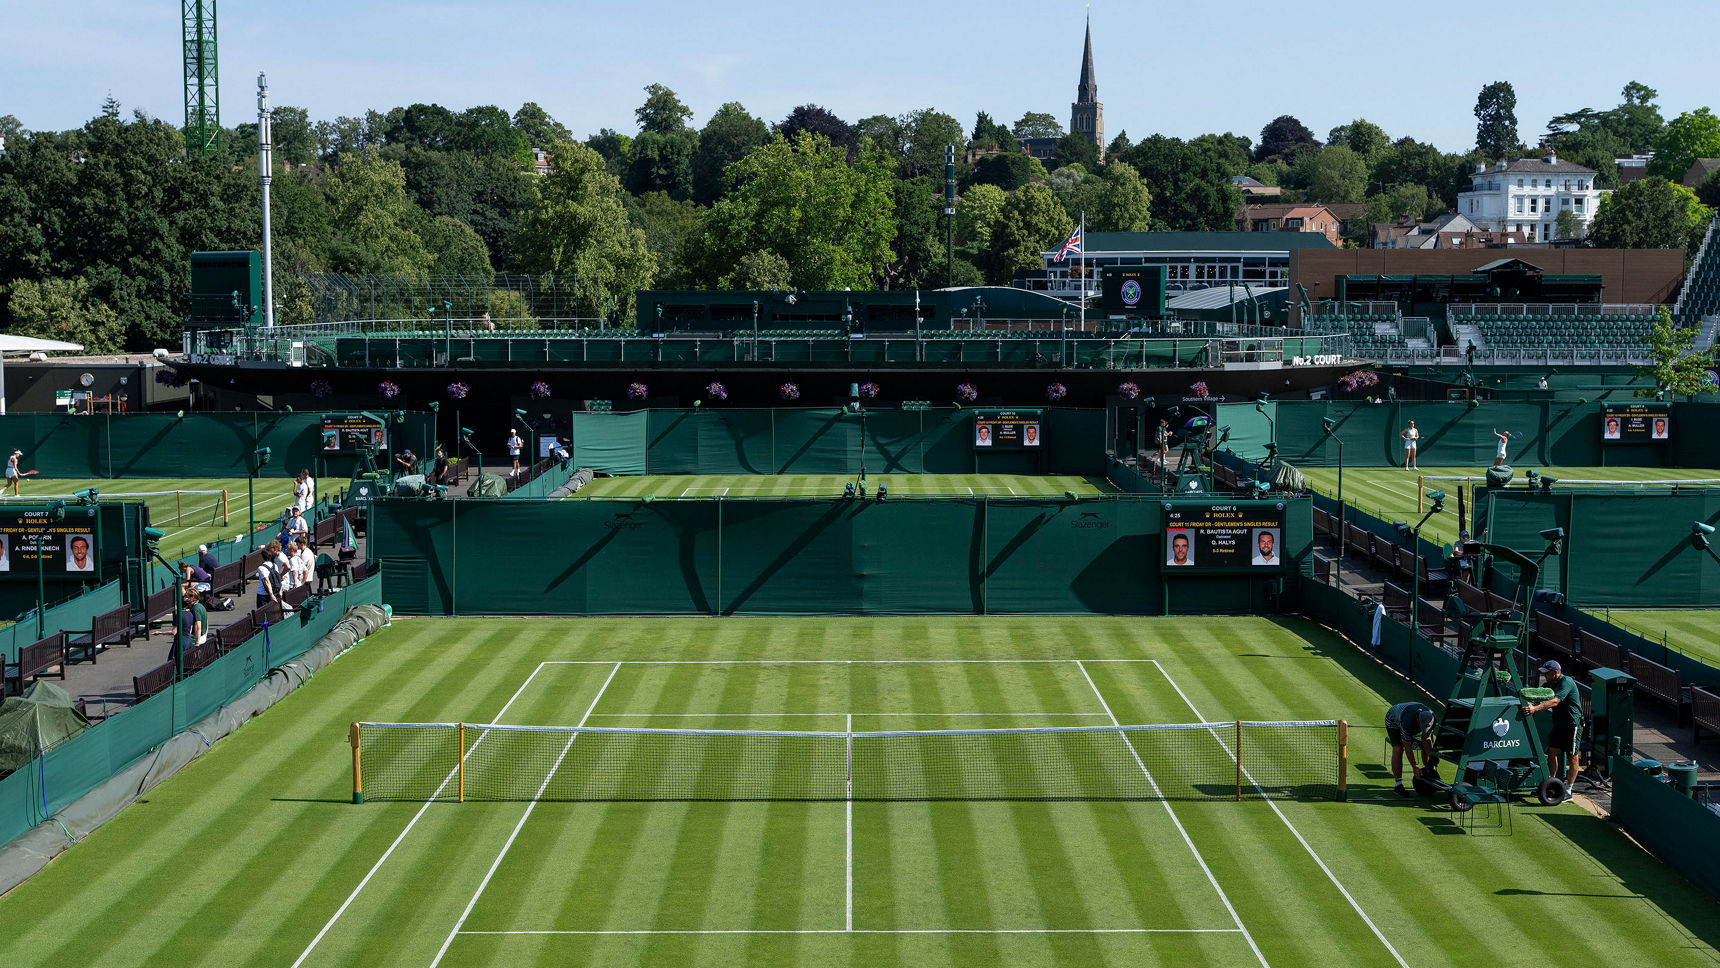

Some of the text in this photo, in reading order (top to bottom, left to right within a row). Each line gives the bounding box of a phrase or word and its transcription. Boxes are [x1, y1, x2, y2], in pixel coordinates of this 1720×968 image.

[1292, 354, 1342, 366] No.2 COURT
[1483, 739, 1520, 748] BARCLAYS
